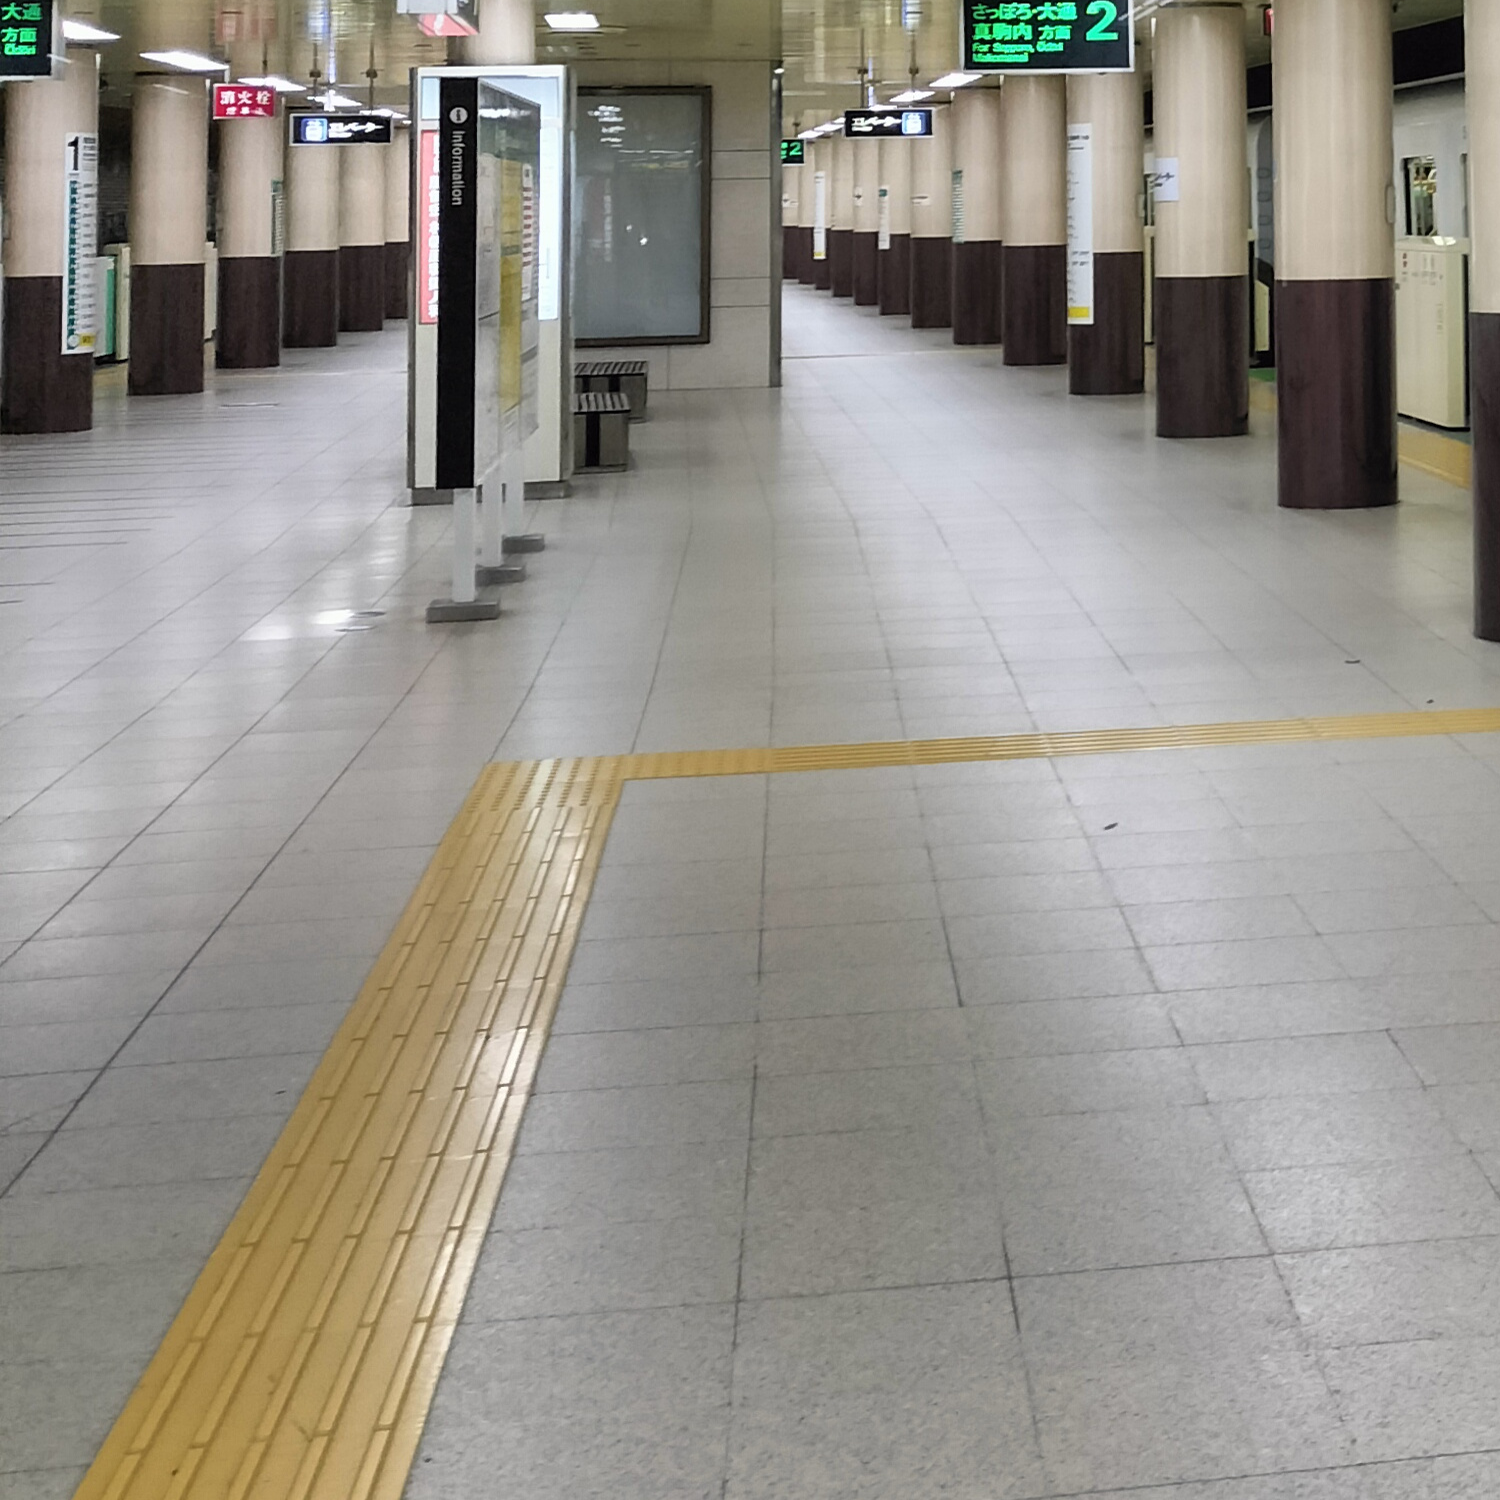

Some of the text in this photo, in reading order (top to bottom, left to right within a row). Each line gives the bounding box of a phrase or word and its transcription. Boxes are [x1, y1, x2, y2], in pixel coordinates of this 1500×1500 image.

[1085, 0, 1119, 42] 2
[451, 129, 467, 207] Information
[789, 141, 802, 156] 2
